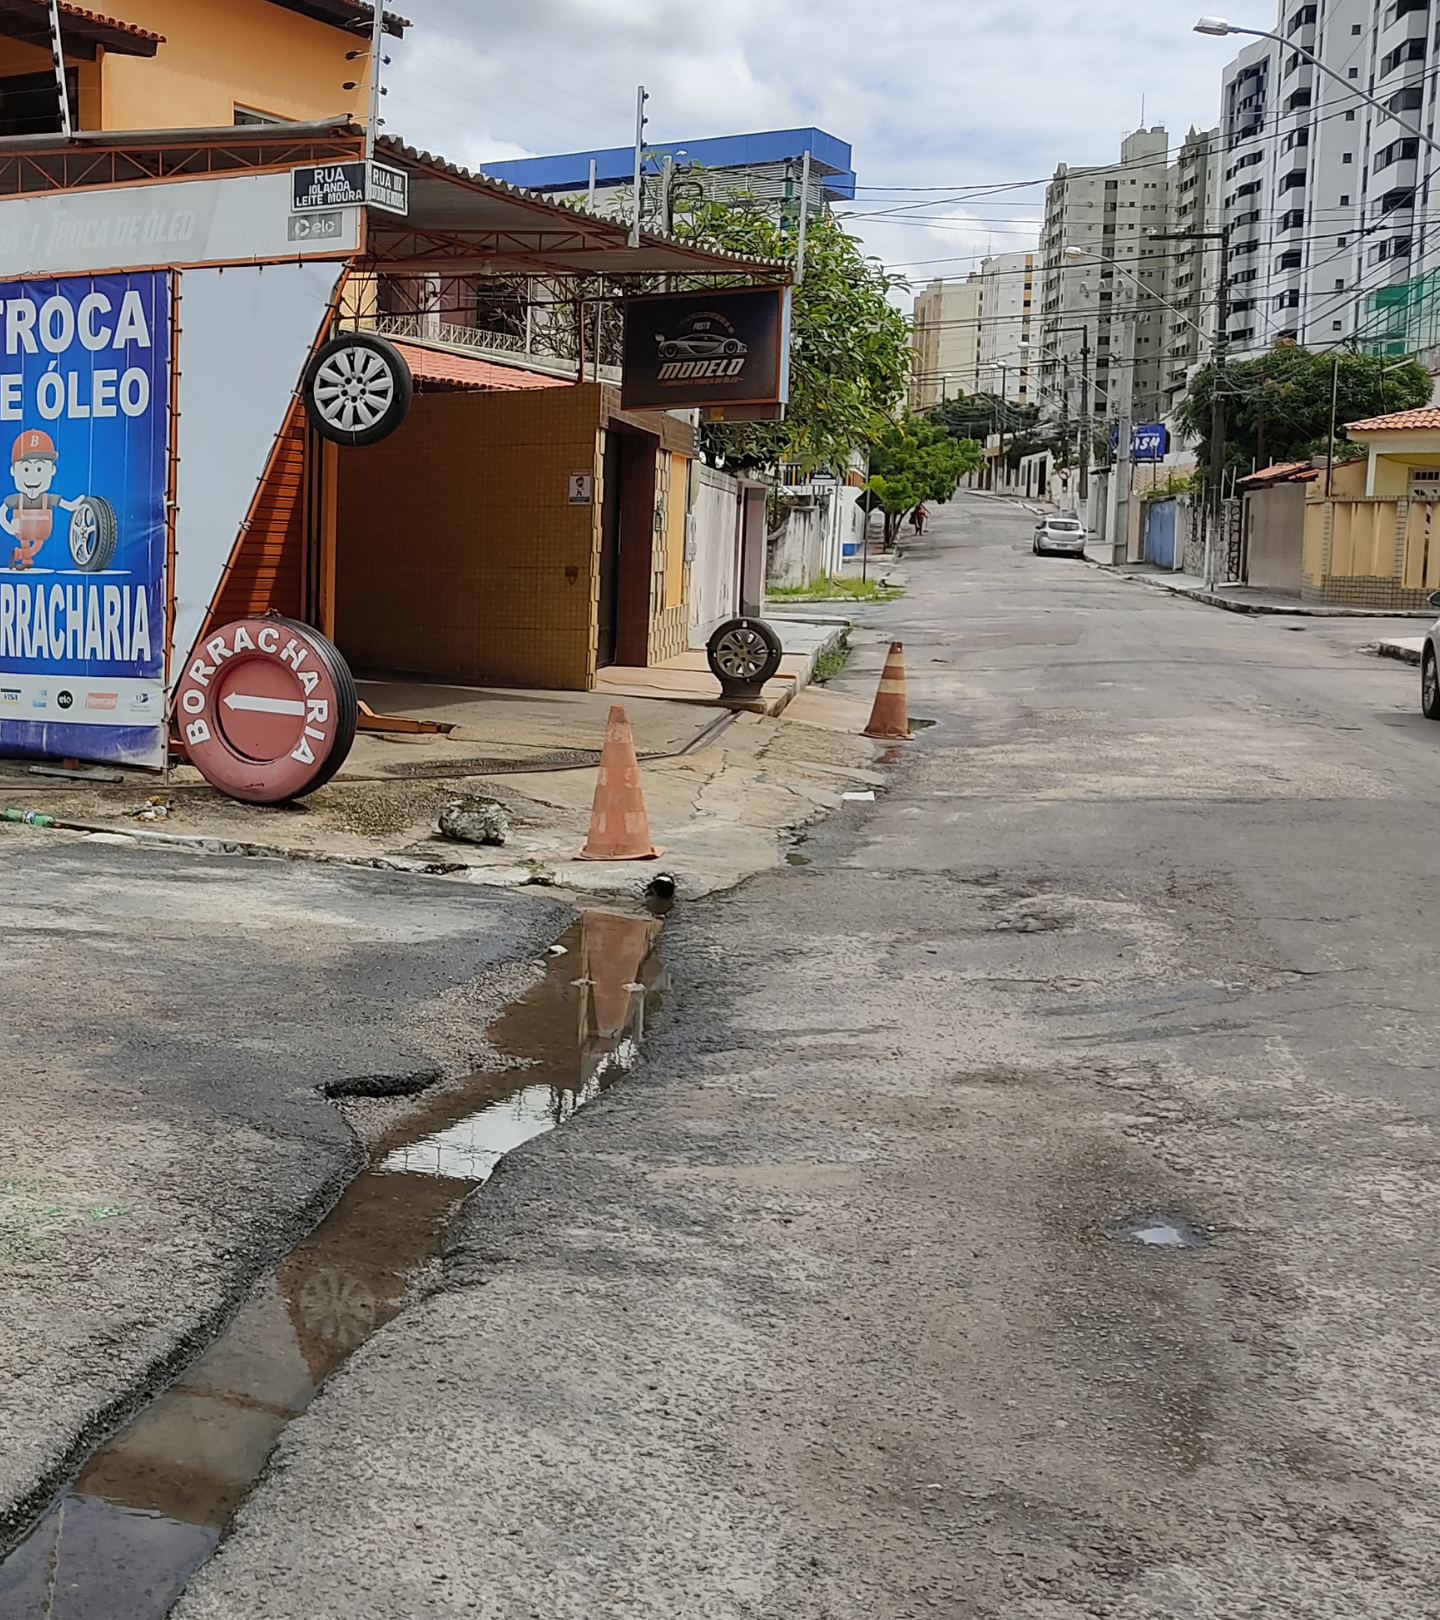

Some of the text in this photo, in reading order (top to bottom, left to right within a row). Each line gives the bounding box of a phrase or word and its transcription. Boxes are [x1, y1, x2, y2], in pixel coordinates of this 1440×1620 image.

[314, 167, 346, 184] RUA
[373, 168, 391, 189] RUA
[308, 180, 350, 195] IOLANDA
[296, 194, 323, 207] LEITE
[328, 190, 363, 204] MOURA
[44, 210, 110, 258] TROCA
[111, 215, 142, 247] DE
[140, 208, 198, 244] ÓLEO
[657, 358, 746, 380] MODELO
[36, 360, 150, 421] ÓLEO
[30, 435, 39, 447] B
[3, 693, 18, 701] VISA
[58, 695, 72, 704] elo
[181, 626, 330, 765] BORRACHARIA
